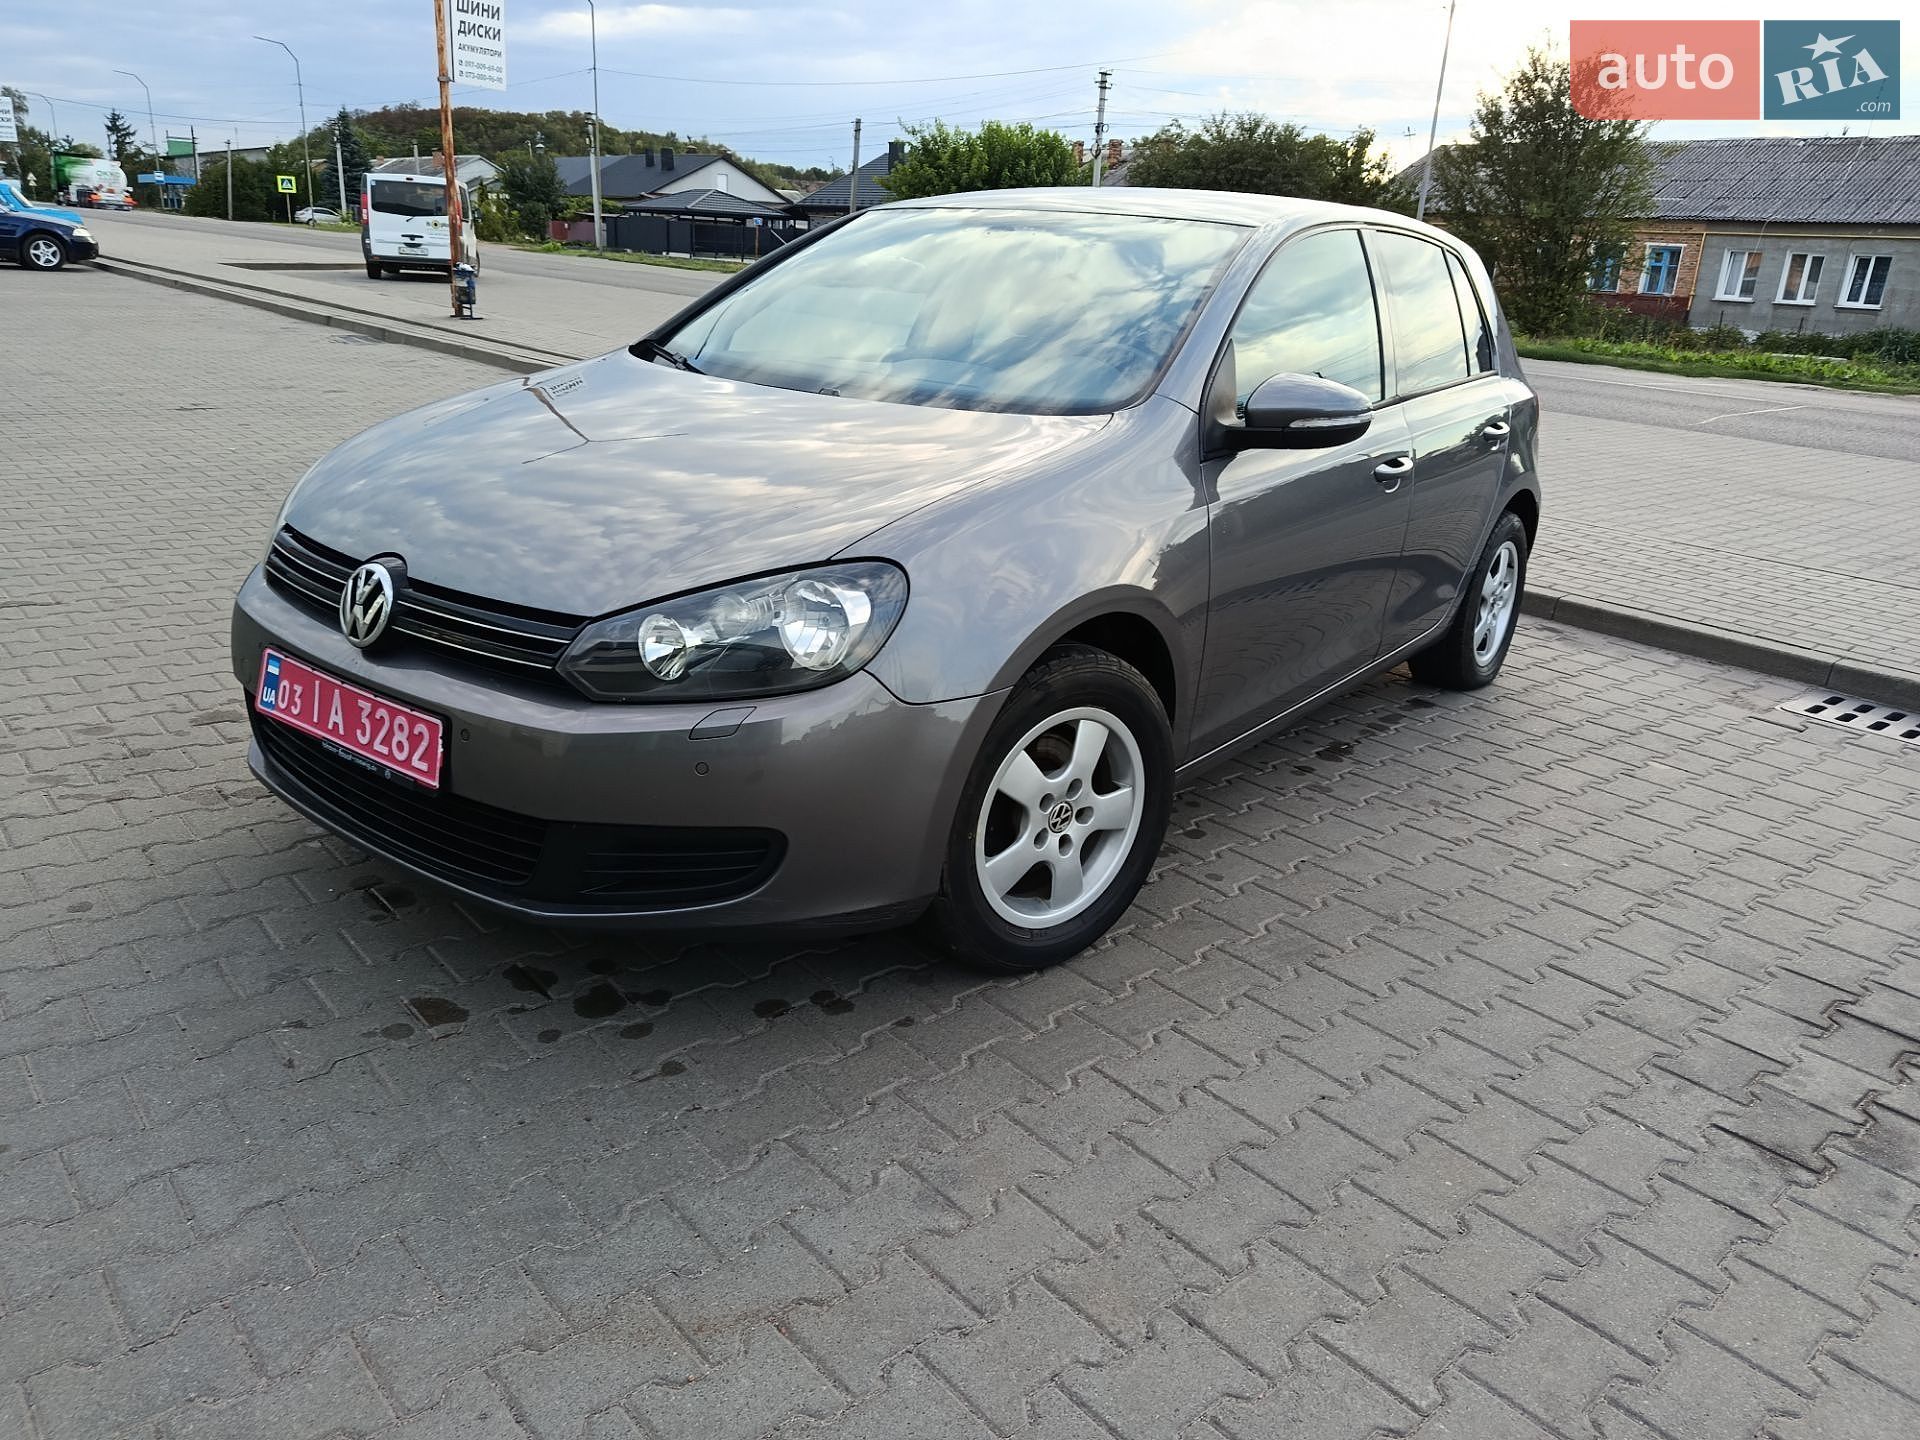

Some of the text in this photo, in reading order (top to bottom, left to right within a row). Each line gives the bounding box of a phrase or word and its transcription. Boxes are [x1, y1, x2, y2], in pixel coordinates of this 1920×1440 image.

[456, 0, 500, 20] ШИНИ
[457, 20, 501, 42] ДИСКИ
[262, 686, 276, 705] UA
[277, 679, 303, 715] 03
[312, 680, 345, 735] IA
[356, 699, 430, 772] 3282
